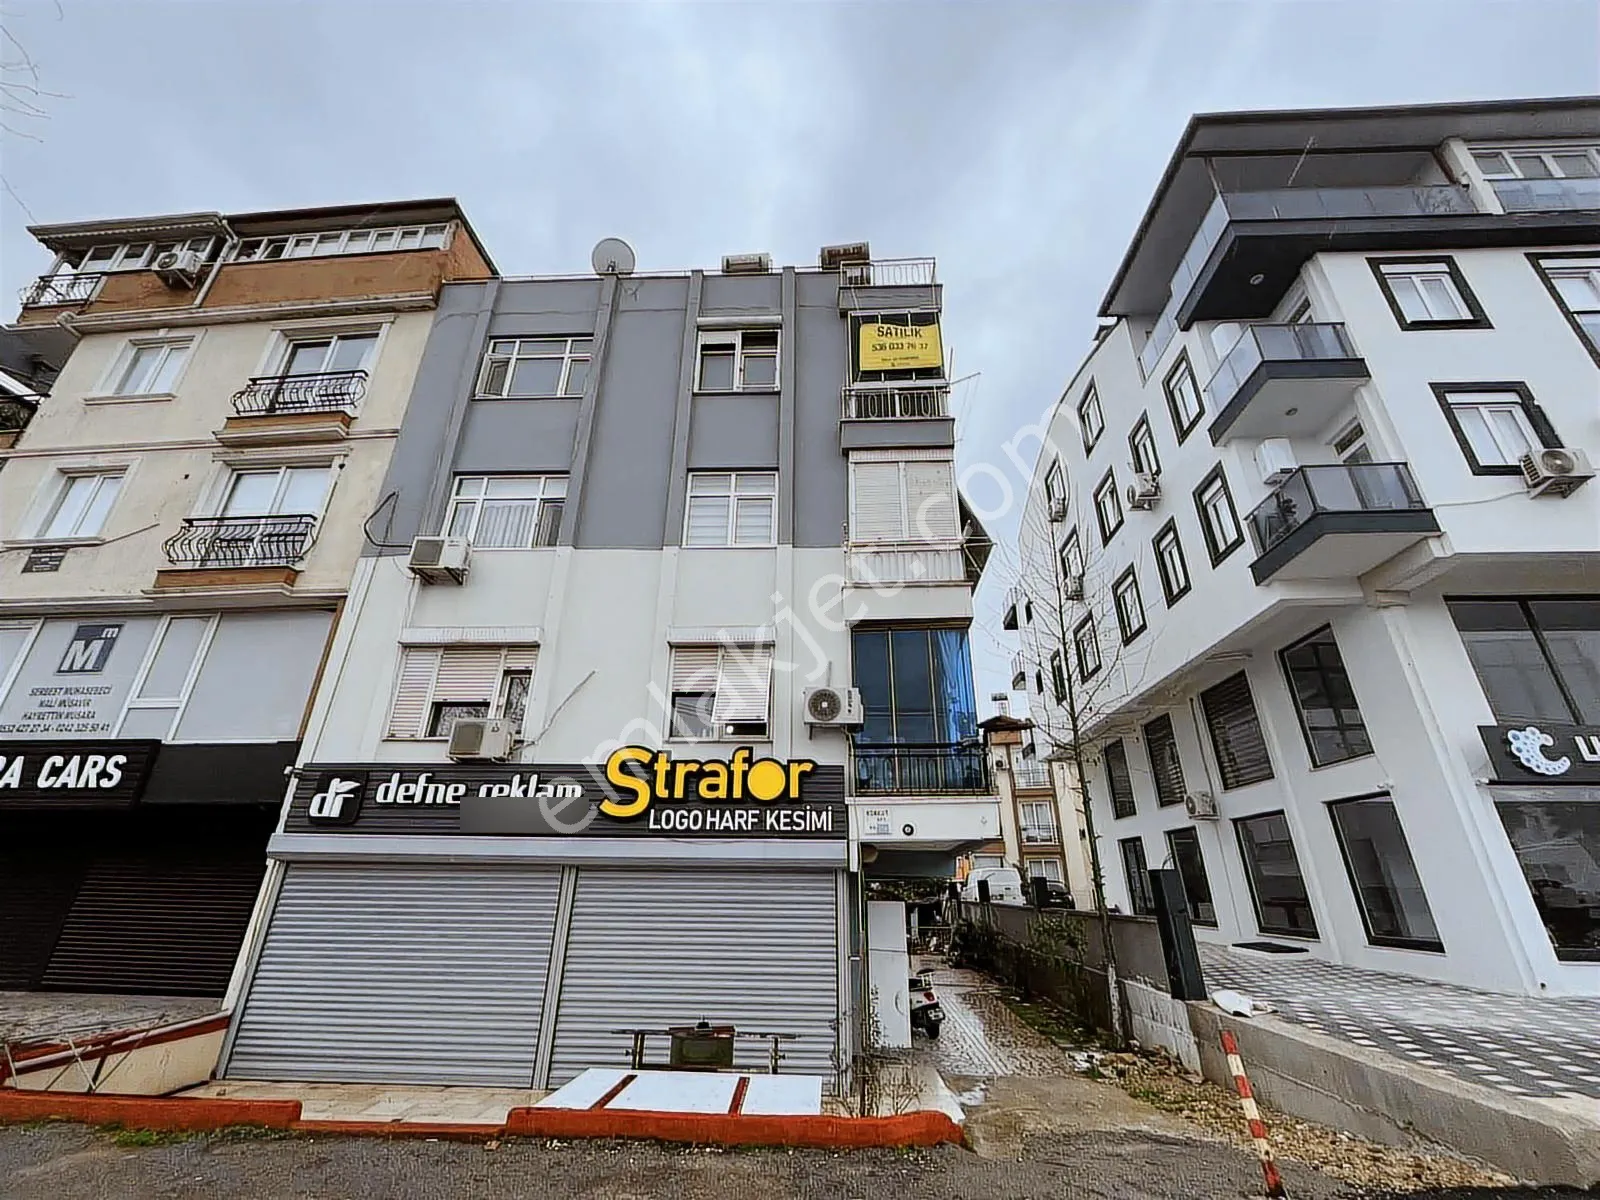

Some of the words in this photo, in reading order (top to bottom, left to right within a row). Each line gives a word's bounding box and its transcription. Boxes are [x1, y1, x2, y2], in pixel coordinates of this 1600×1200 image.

[877, 325, 922, 338] SATILIK
[37, 754, 128, 789] CARS
[599, 746, 814, 818] Strafor
[376, 772, 461, 804] defne
[648, 808, 703, 831] LOGO
[705, 809, 760, 831] HARF
[765, 805, 833, 832] KESİMİ
